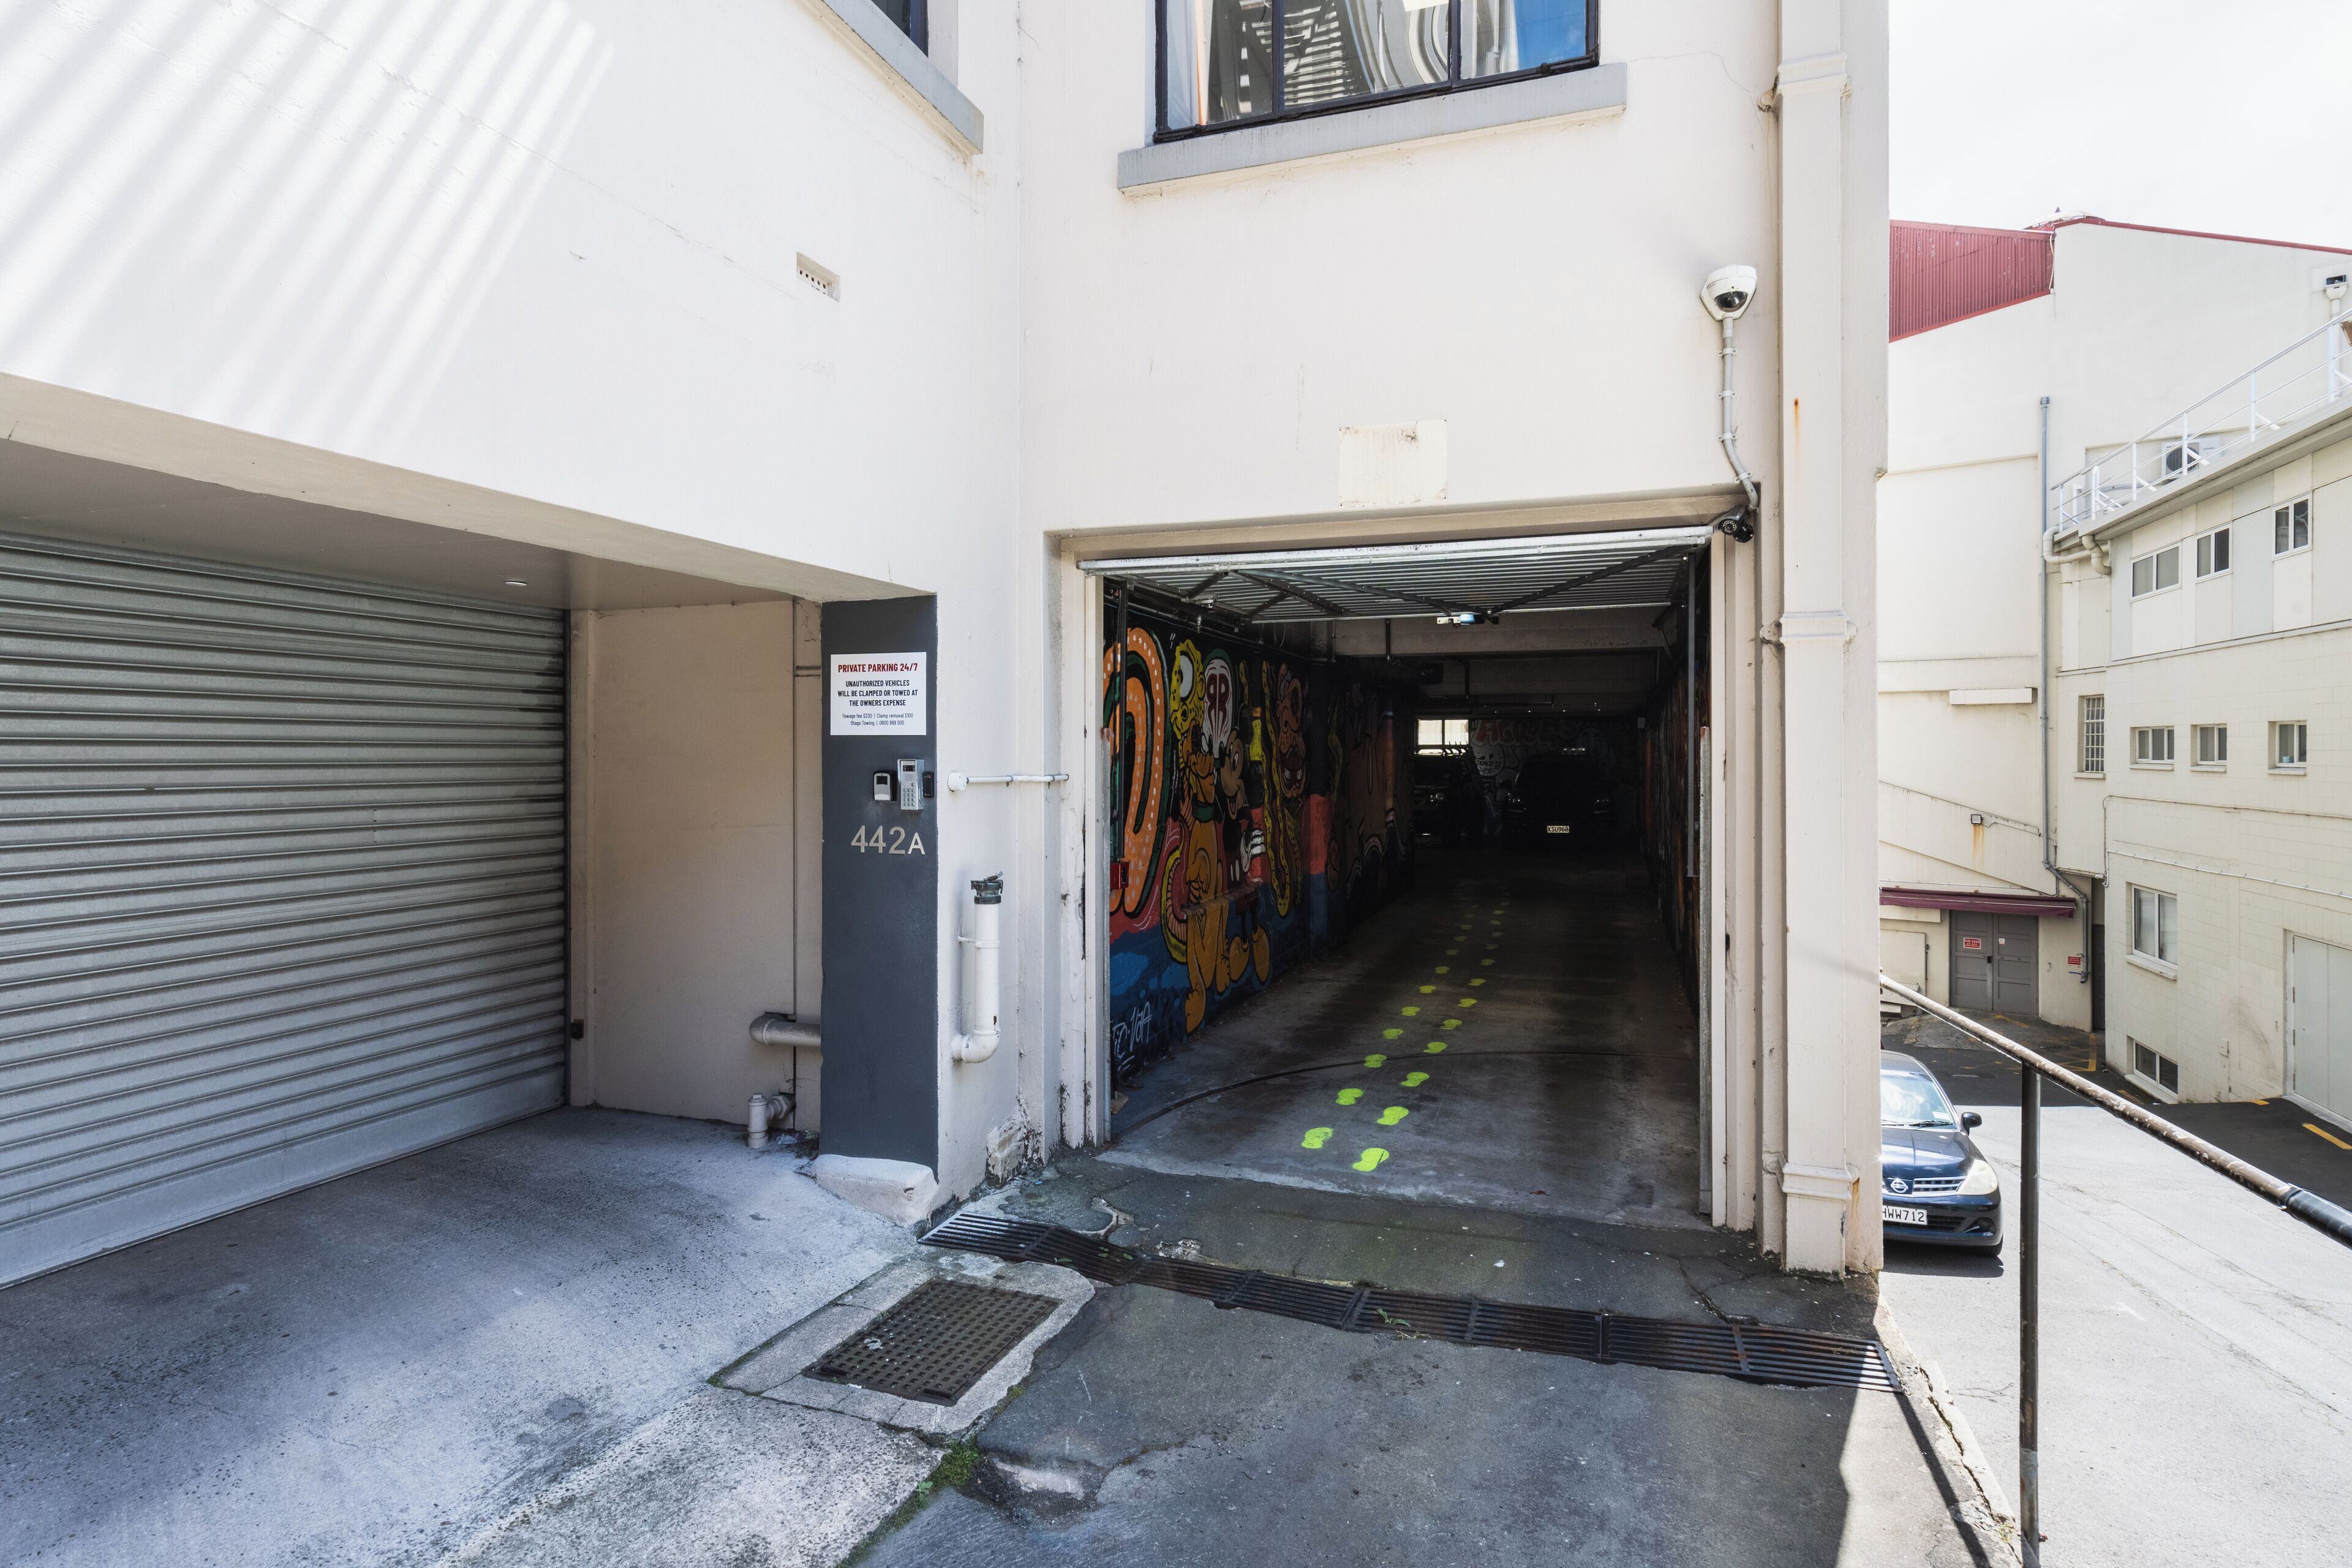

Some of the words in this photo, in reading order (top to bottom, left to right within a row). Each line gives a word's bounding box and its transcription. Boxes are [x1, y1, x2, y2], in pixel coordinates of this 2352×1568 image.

[838, 664, 866, 673] PRIVATE
[868, 663, 898, 672] PARKING
[900, 663, 918, 672] 24/7
[851, 825, 925, 855] 442A
